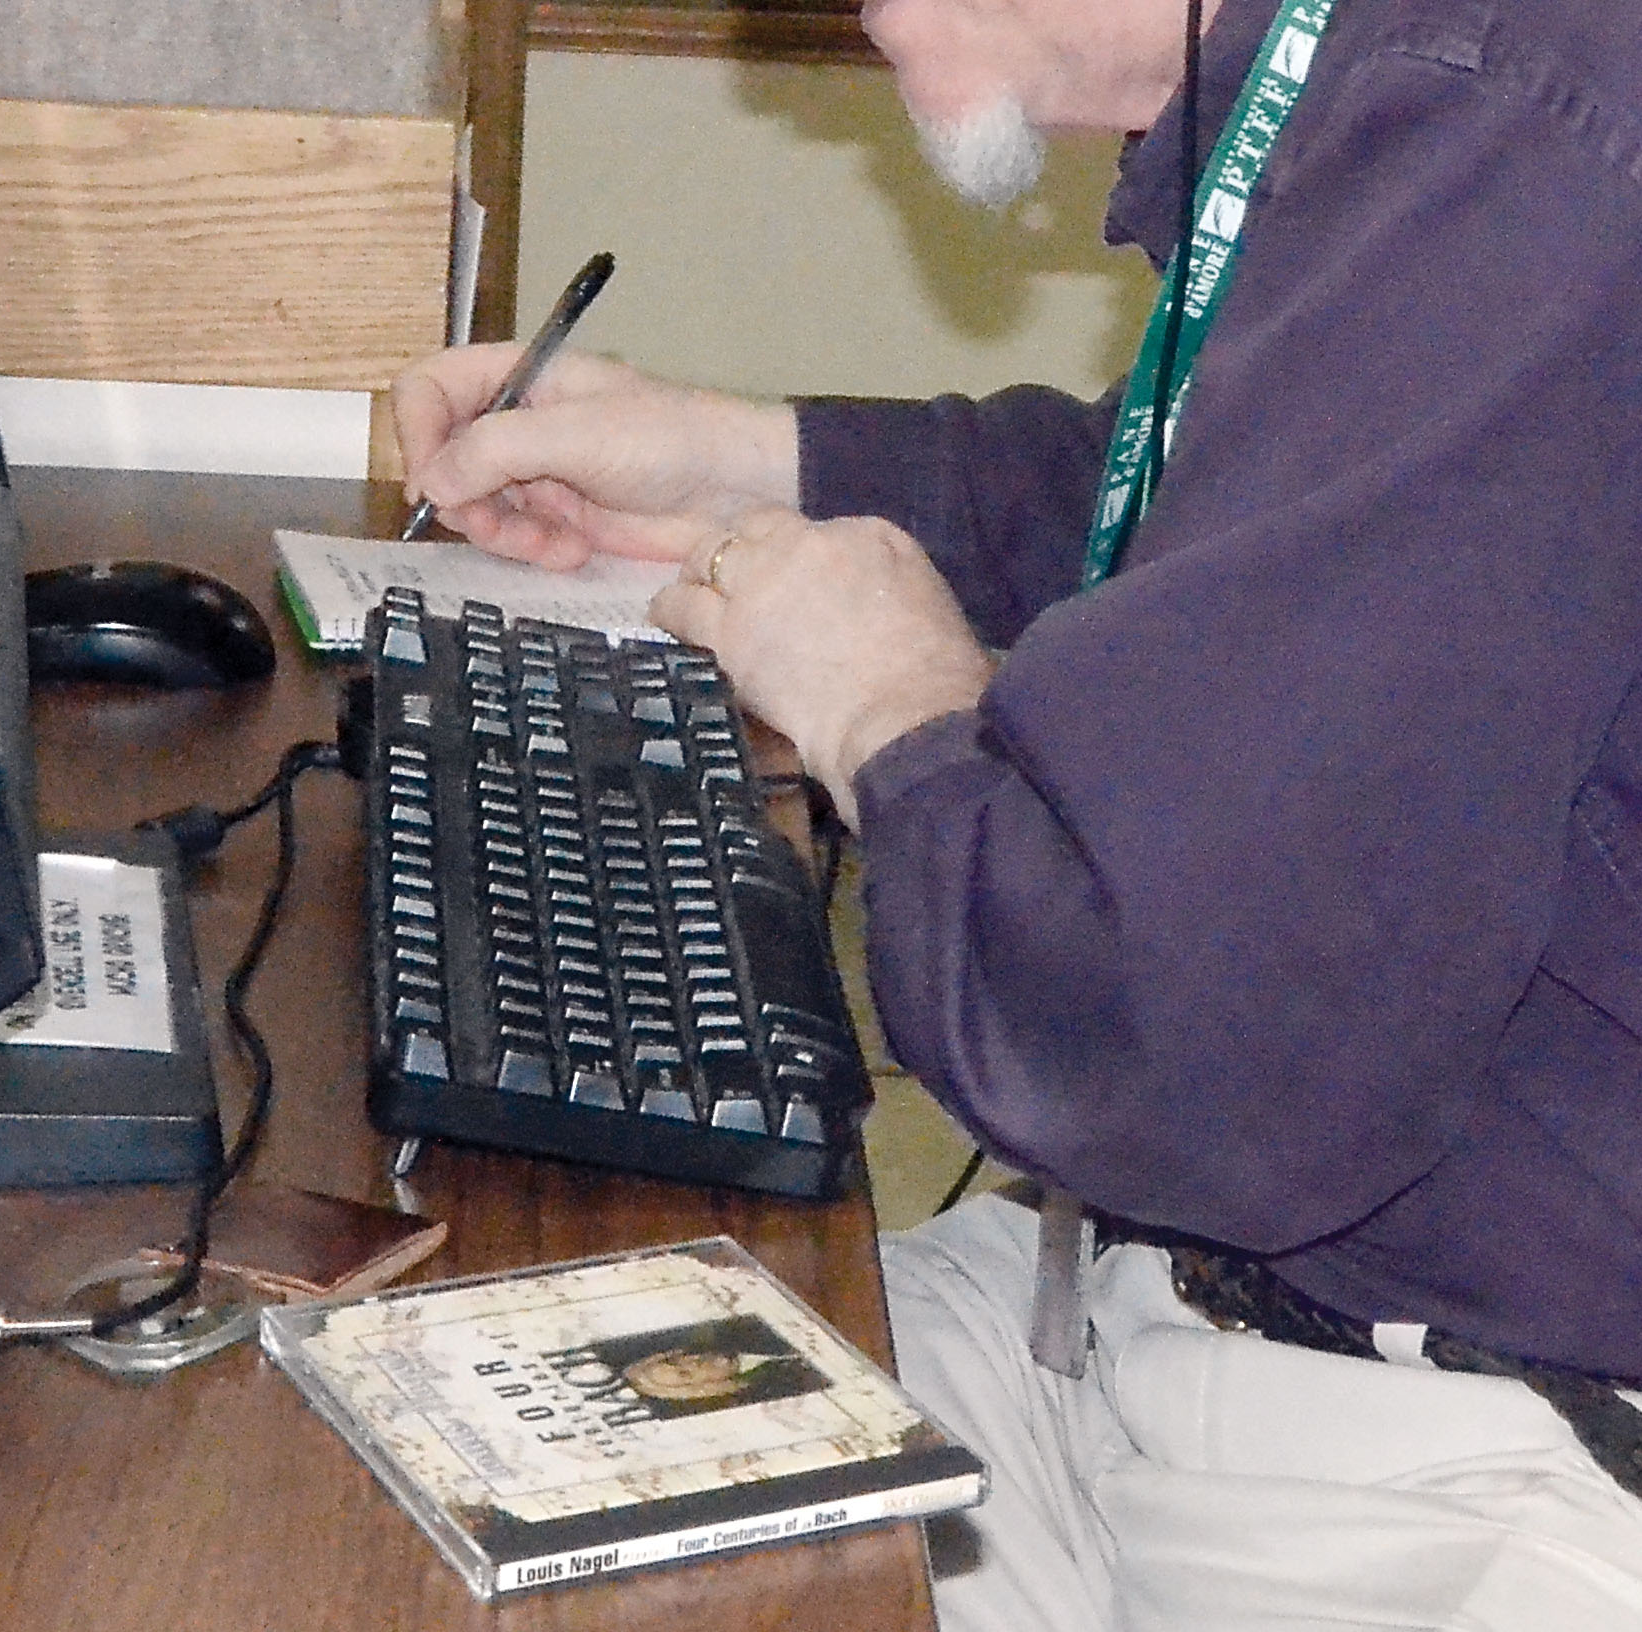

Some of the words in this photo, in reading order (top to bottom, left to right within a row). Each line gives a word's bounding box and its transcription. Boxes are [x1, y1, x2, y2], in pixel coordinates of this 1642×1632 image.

[1184, 242, 1232, 320] d'AMORE
[473, 1360, 576, 1443] FOUR
[517, 1560, 563, 1585] Louis
[570, 1548, 620, 1575] Nagel
[677, 1535, 709, 1554] Four
[713, 1522, 781, 1548] Centuries
[784, 1516, 798, 1532] of
[814, 1507, 848, 1527] Bach
